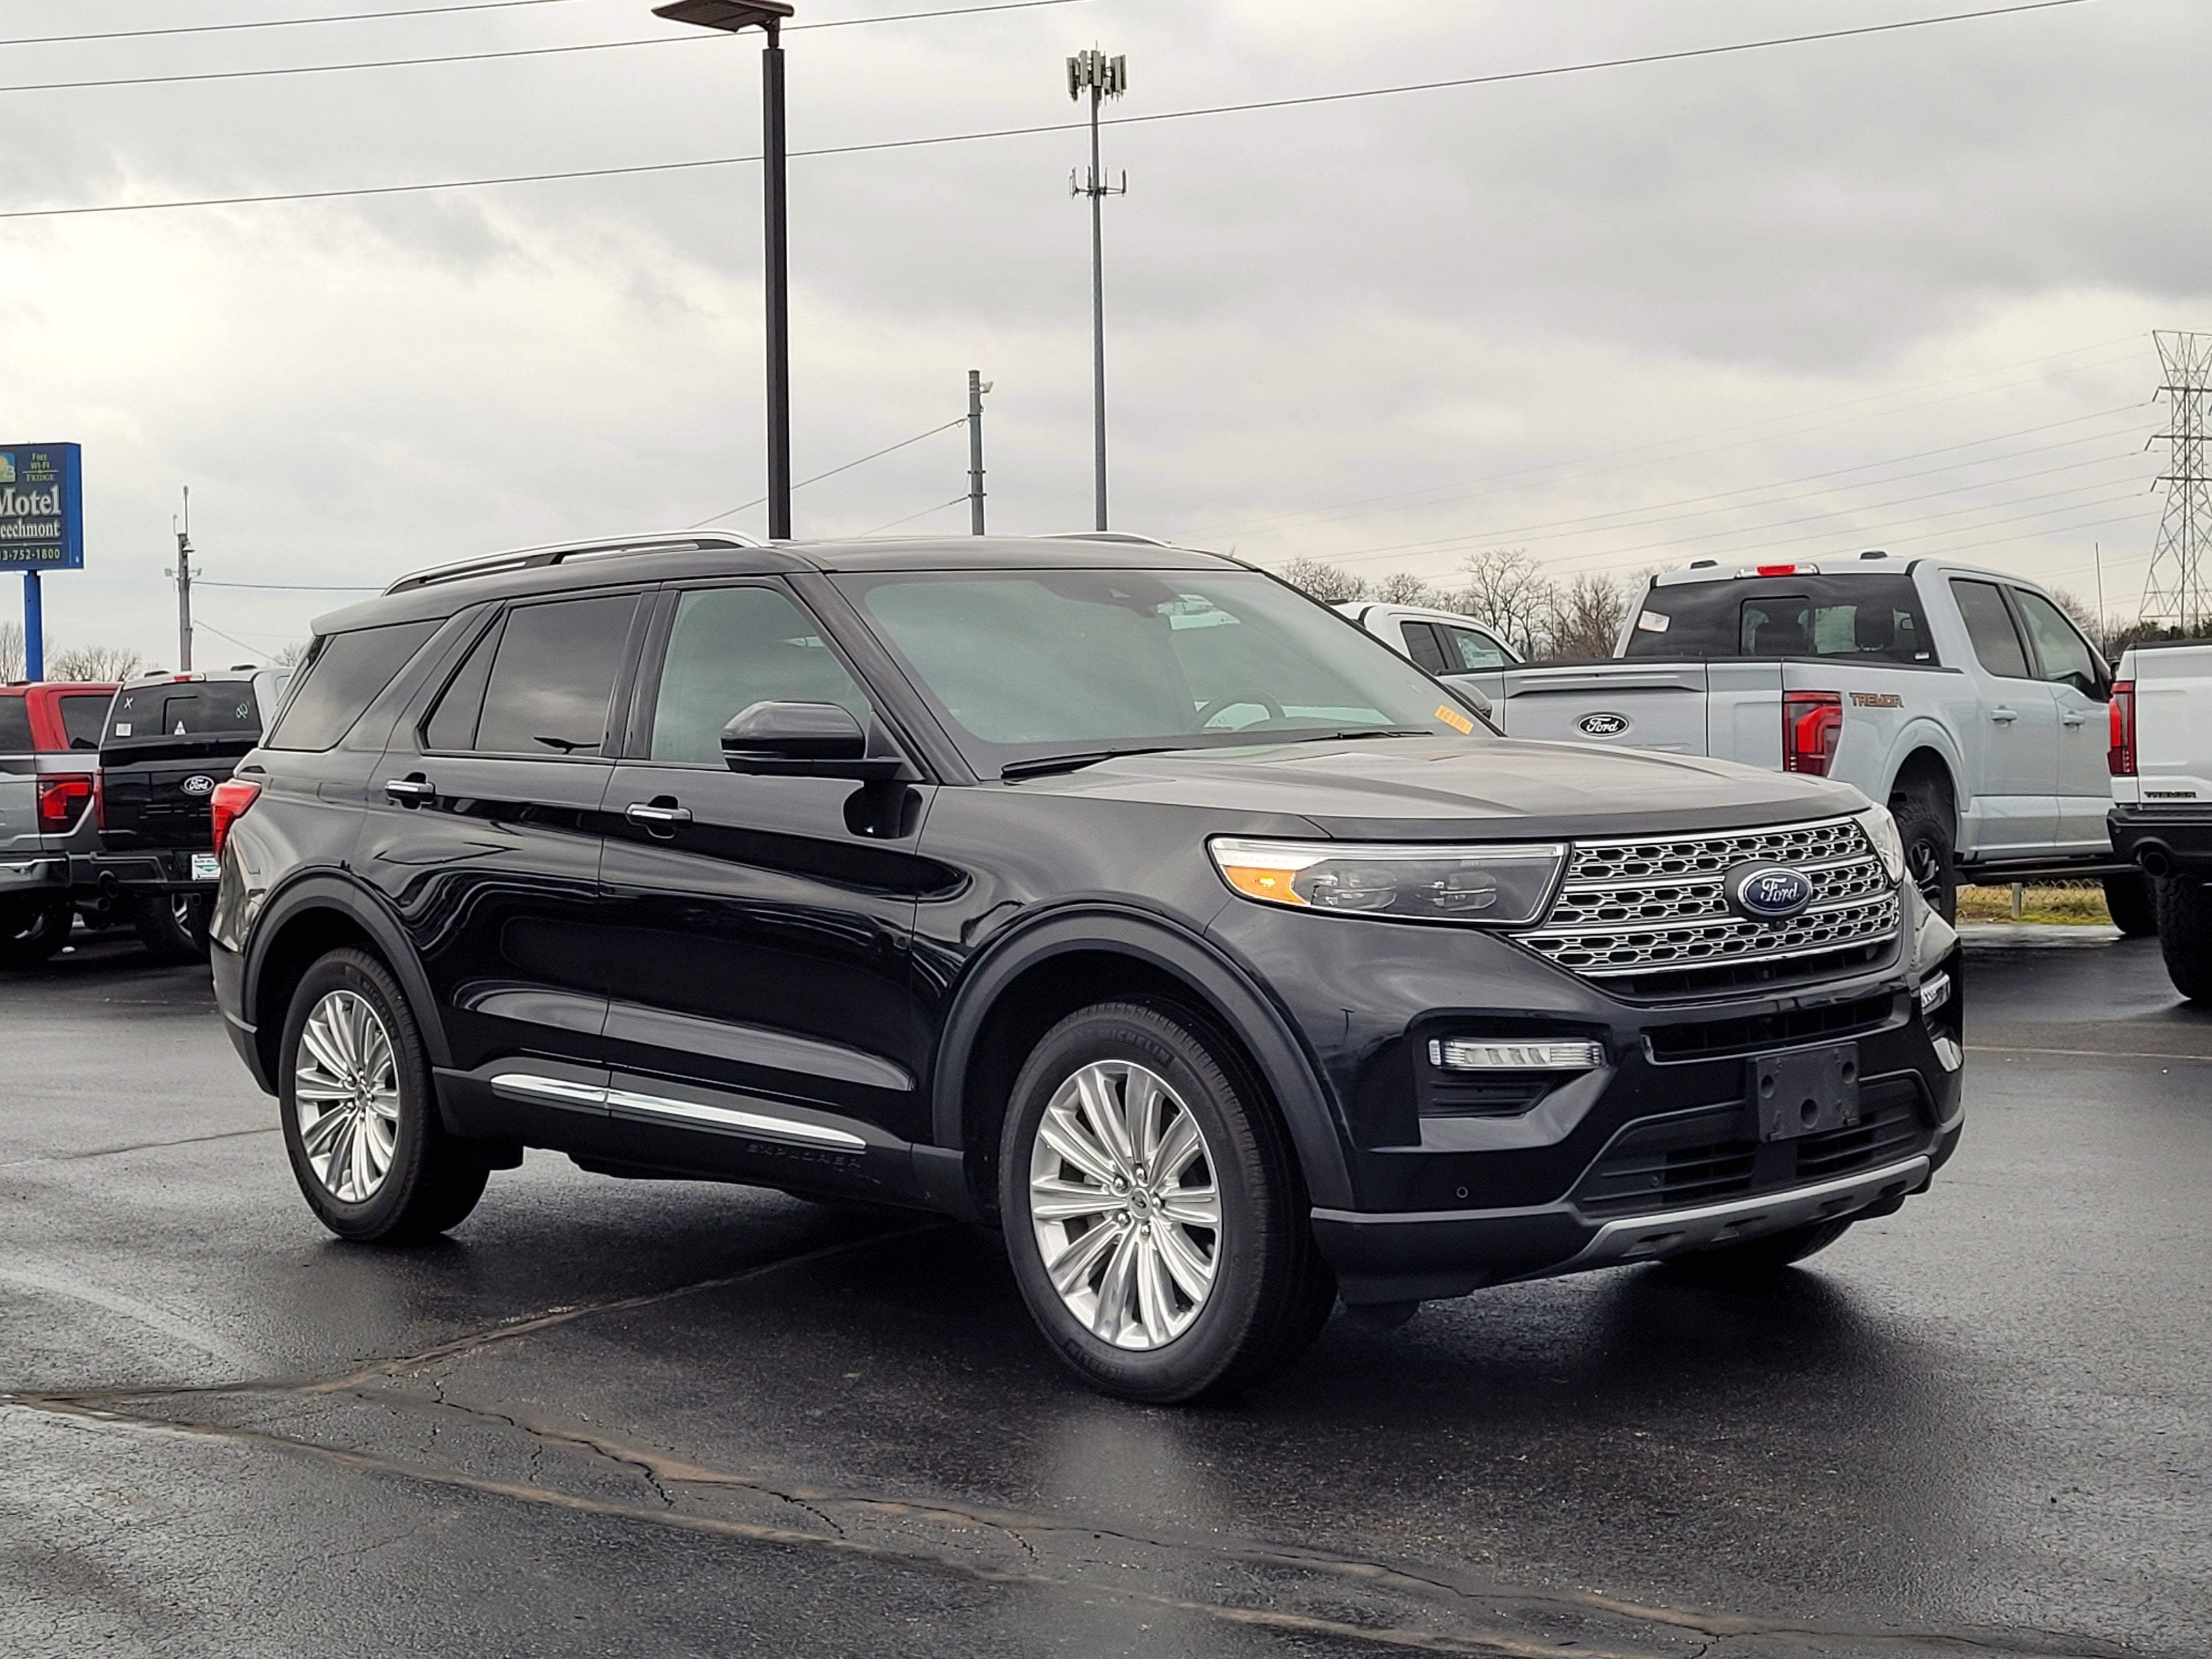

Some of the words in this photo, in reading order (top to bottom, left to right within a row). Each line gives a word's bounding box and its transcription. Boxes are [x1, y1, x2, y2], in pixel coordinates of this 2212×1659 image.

[0, 483, 61, 516] Motel
[1849, 692, 1905, 708] TREMOR
[1586, 717, 1620, 732] Ford
[189, 778, 209, 790] Ford
[1760, 877, 1799, 902] Ford
